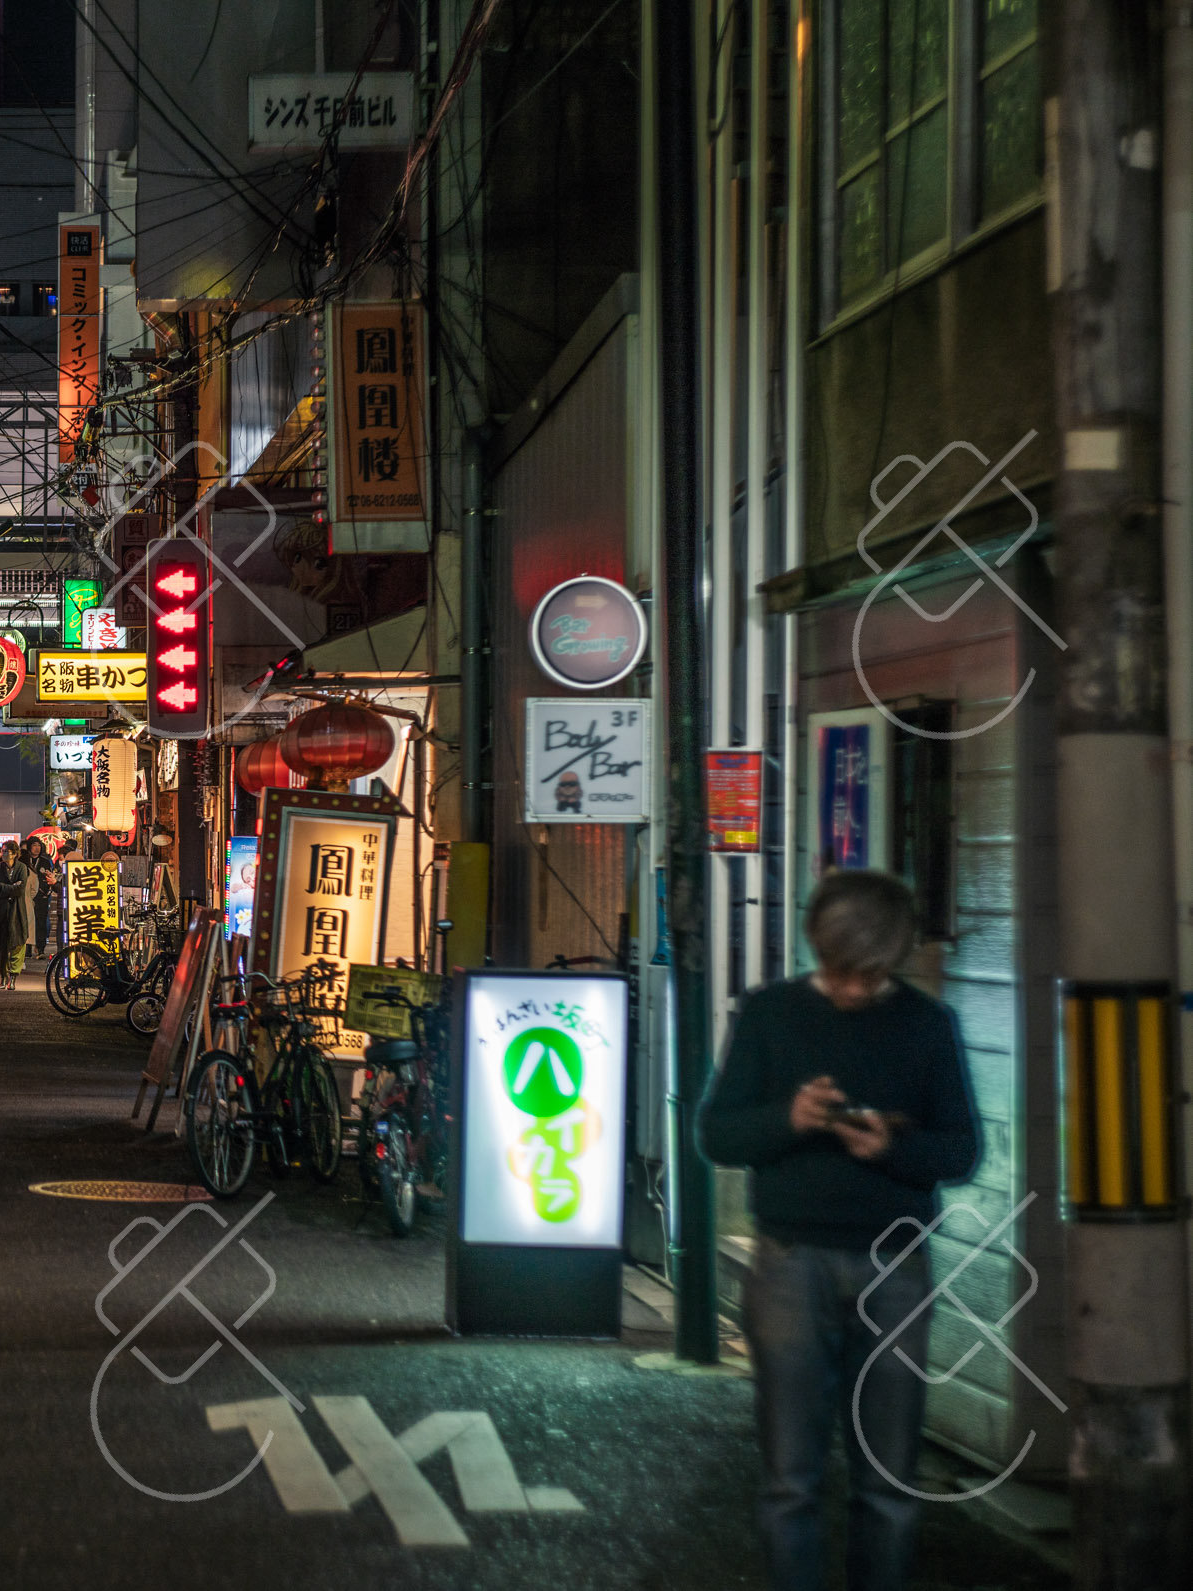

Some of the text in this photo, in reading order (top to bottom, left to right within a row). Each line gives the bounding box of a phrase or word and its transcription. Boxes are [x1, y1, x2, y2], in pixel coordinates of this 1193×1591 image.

[355, 327, 399, 482] 鳳凰楼
[42, 661, 75, 676] 大阪
[42, 679, 75, 693] 名物
[76, 664, 147, 690] 串かつ
[611, 711, 638, 727] 3F
[96, 745, 111, 798] 大阪名物
[588, 751, 642, 779] Bar
[358, 832, 378, 901] 中華料理
[107, 872, 116, 919] 大阪名物
[72, 865, 105, 968] 営業
